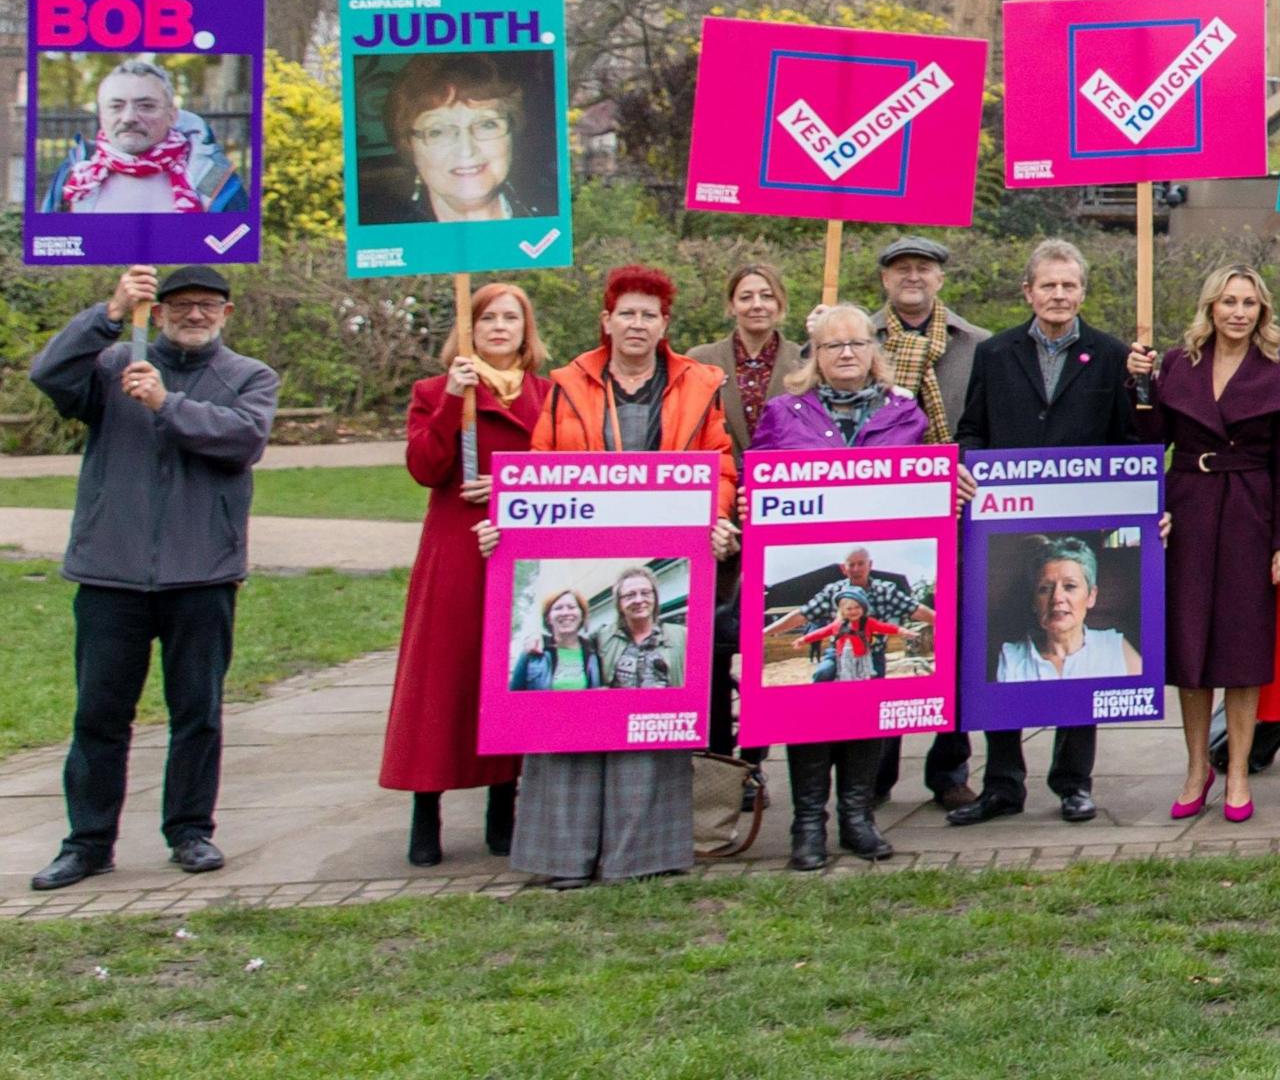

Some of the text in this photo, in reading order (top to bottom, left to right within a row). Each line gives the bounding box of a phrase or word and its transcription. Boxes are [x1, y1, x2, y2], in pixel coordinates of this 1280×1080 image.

[350, 0, 414, 9] CAMPAIGN
[353, 11, 555, 48] JUDITH.
[1092, 25, 1224, 132] YES TO DIGNITY
[790, 71, 940, 169] YES TO DIGNITY
[500, 464, 711, 485] CAMPAIGN FOR
[753, 457, 950, 483] CAMPAIGN FOR
[972, 456, 1157, 481] CAMPAIGN FOR
[508, 497, 595, 525] Gypie
[761, 494, 824, 517] Paul
[979, 493, 1034, 513] Ann
[1093, 693, 1153, 707] DIGNITY
[880, 703, 943, 718] DIGNITY
[1093, 704, 1158, 718] IN DYING.
[628, 718, 696, 731] DIGNITY
[880, 713, 948, 730] IN DYING.
[628, 729, 701, 742] IN DYING.
